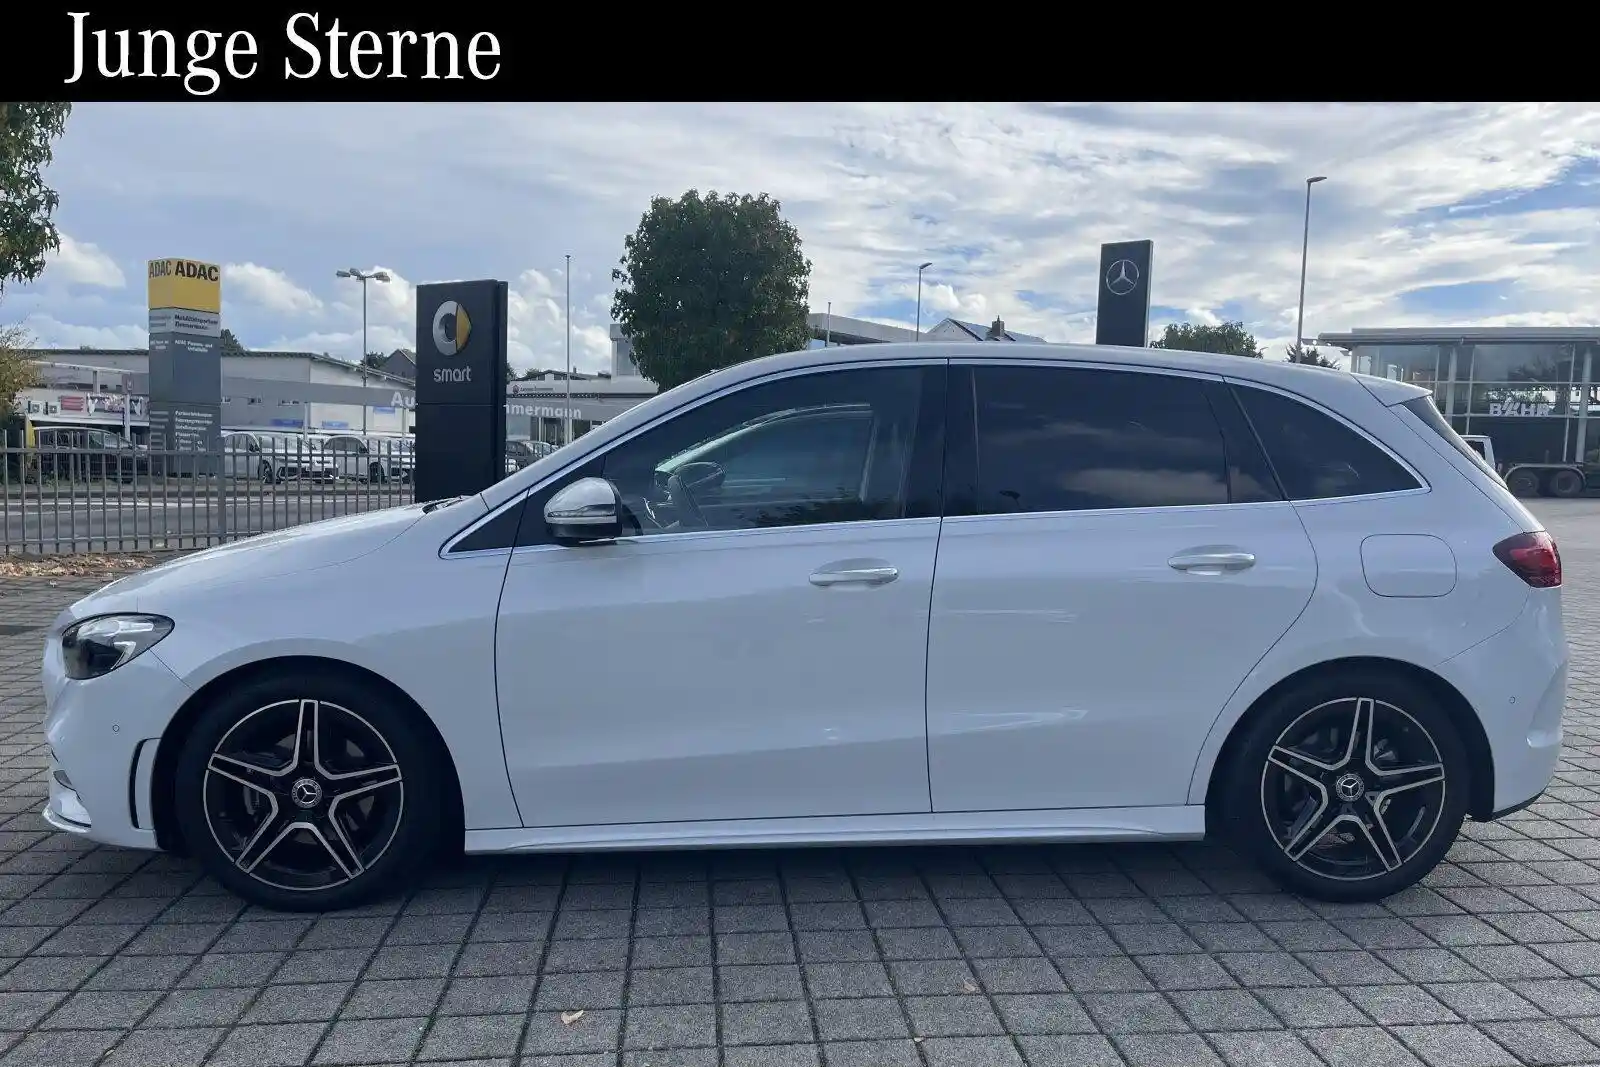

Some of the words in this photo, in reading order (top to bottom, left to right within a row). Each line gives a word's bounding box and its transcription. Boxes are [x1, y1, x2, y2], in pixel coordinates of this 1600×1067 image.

[149, 261, 171, 278] ADAC
[175, 261, 219, 281] ADAC
[433, 366, 472, 382] smart
